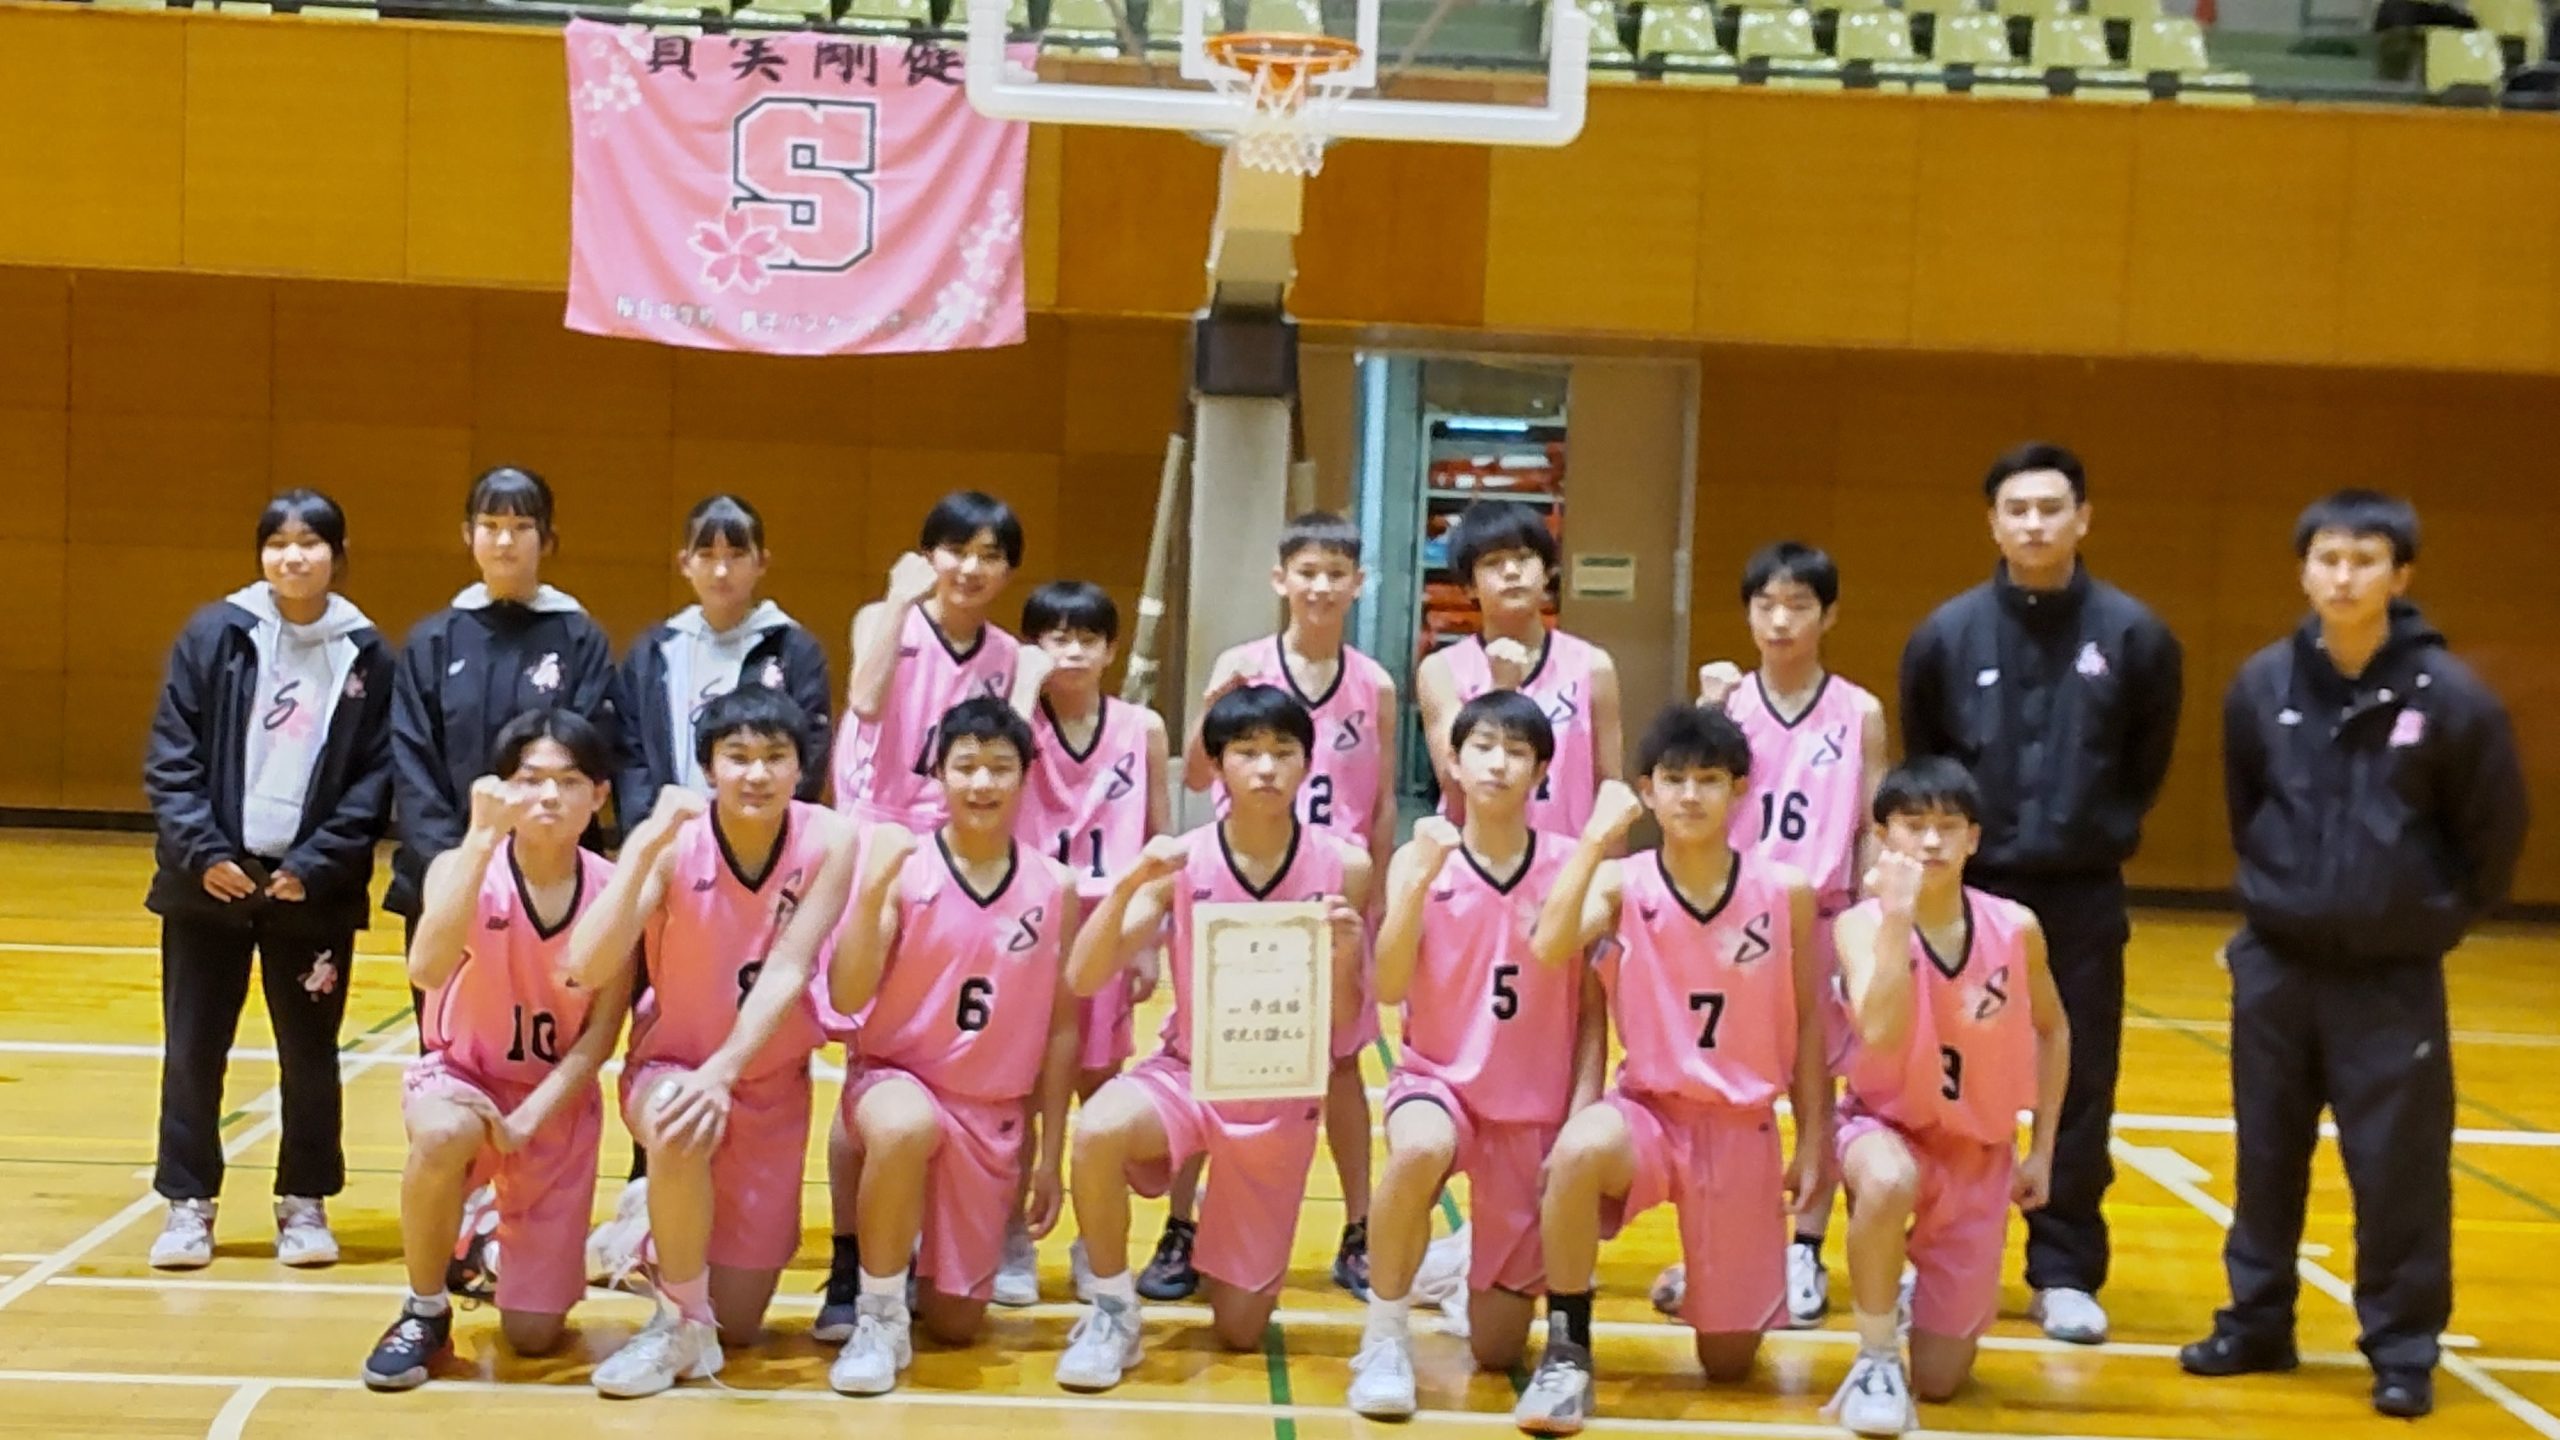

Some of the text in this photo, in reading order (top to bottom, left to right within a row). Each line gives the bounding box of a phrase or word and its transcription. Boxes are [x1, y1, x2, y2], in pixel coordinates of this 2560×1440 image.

[732, 97, 877, 273] S
[263, 679, 301, 731] S
[1334, 710, 1366, 752] S
[1811, 724, 1847, 768] S
[1760, 791, 1810, 842] 16
[1056, 828, 1105, 878] 11
[1008, 905, 1044, 952] S
[1735, 911, 1771, 964] S
[956, 976, 993, 1031] 6
[1491, 964, 1520, 1019] 5
[1975, 966, 2009, 1019] S
[506, 1004, 560, 1064] 10
[1689, 993, 1725, 1049] 7
[1940, 1045, 1963, 1101] 9
